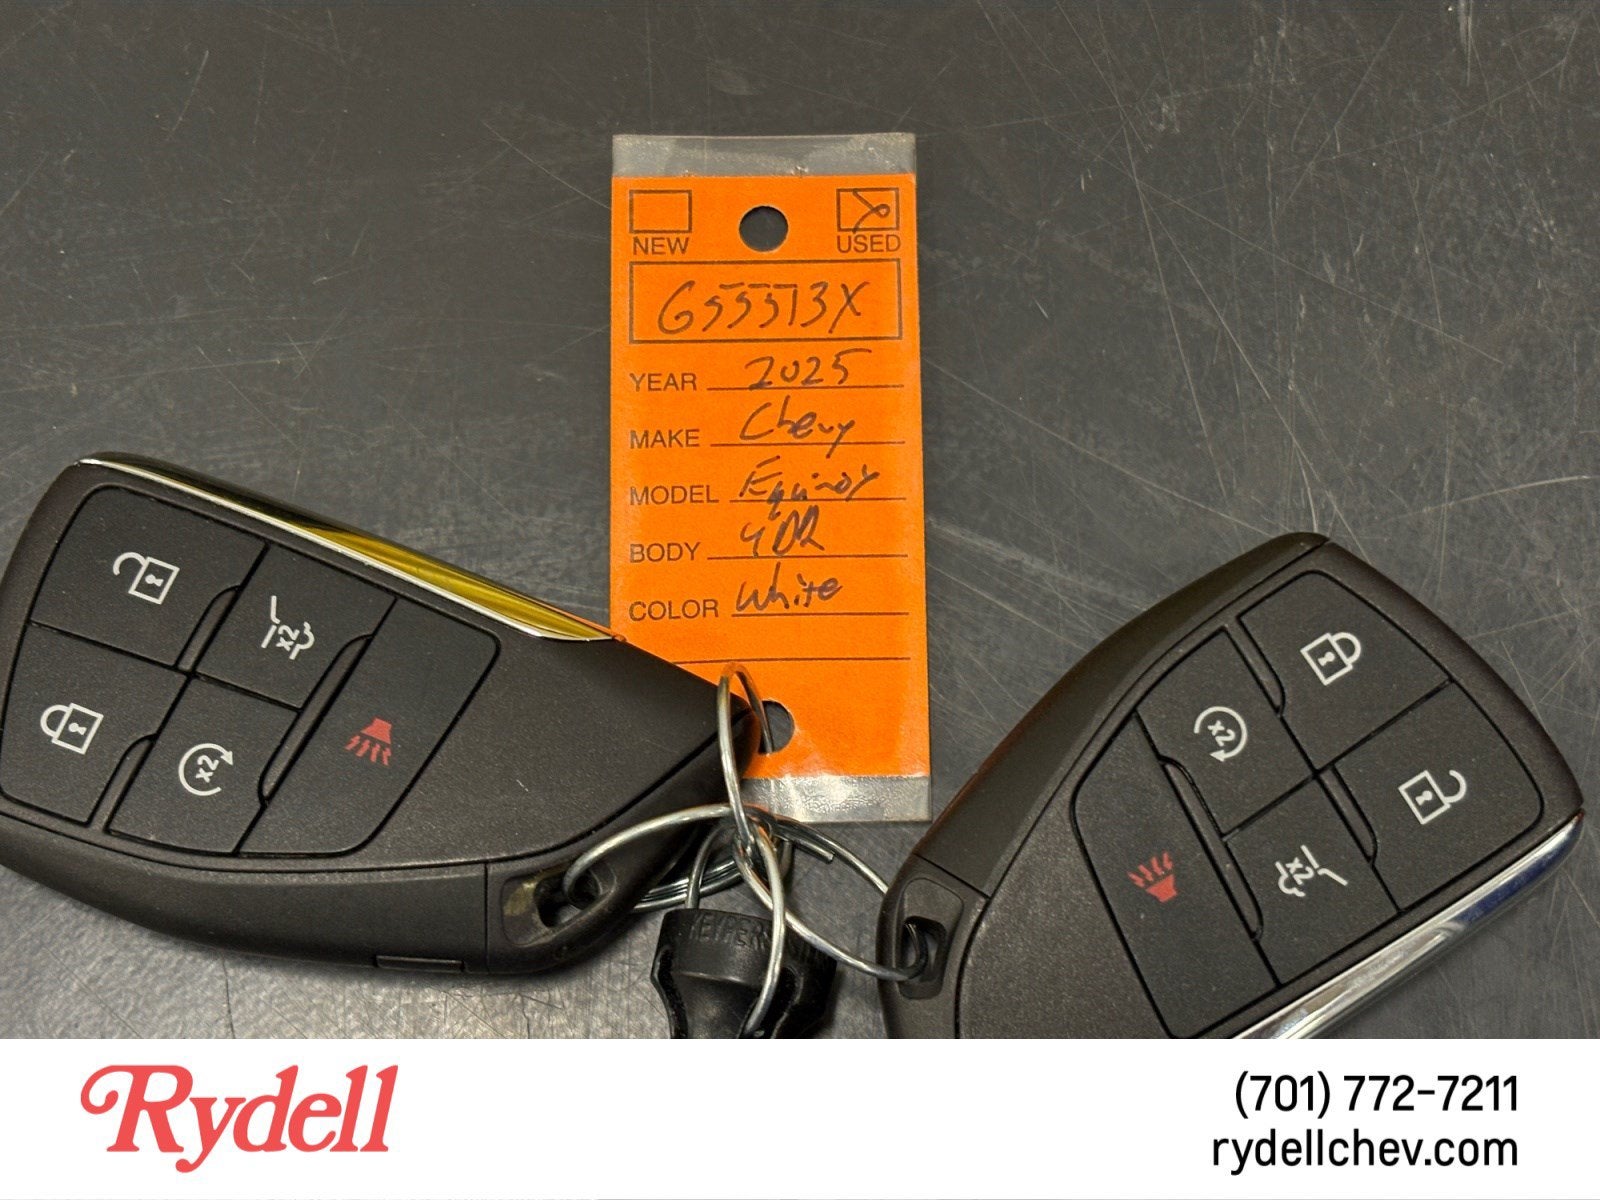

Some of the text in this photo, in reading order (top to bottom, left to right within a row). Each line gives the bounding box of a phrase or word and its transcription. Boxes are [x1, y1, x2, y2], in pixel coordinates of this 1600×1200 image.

[632, 237, 689, 255] NEW
[837, 234, 901, 253] USED
[744, 348, 873, 389] 2025
[629, 372, 697, 391] YEAR
[739, 395, 855, 459] Chevy
[629, 429, 700, 449] MAKE
[629, 485, 719, 506] MODEL
[629, 542, 701, 563] BODY
[629, 599, 719, 621] COLOR
